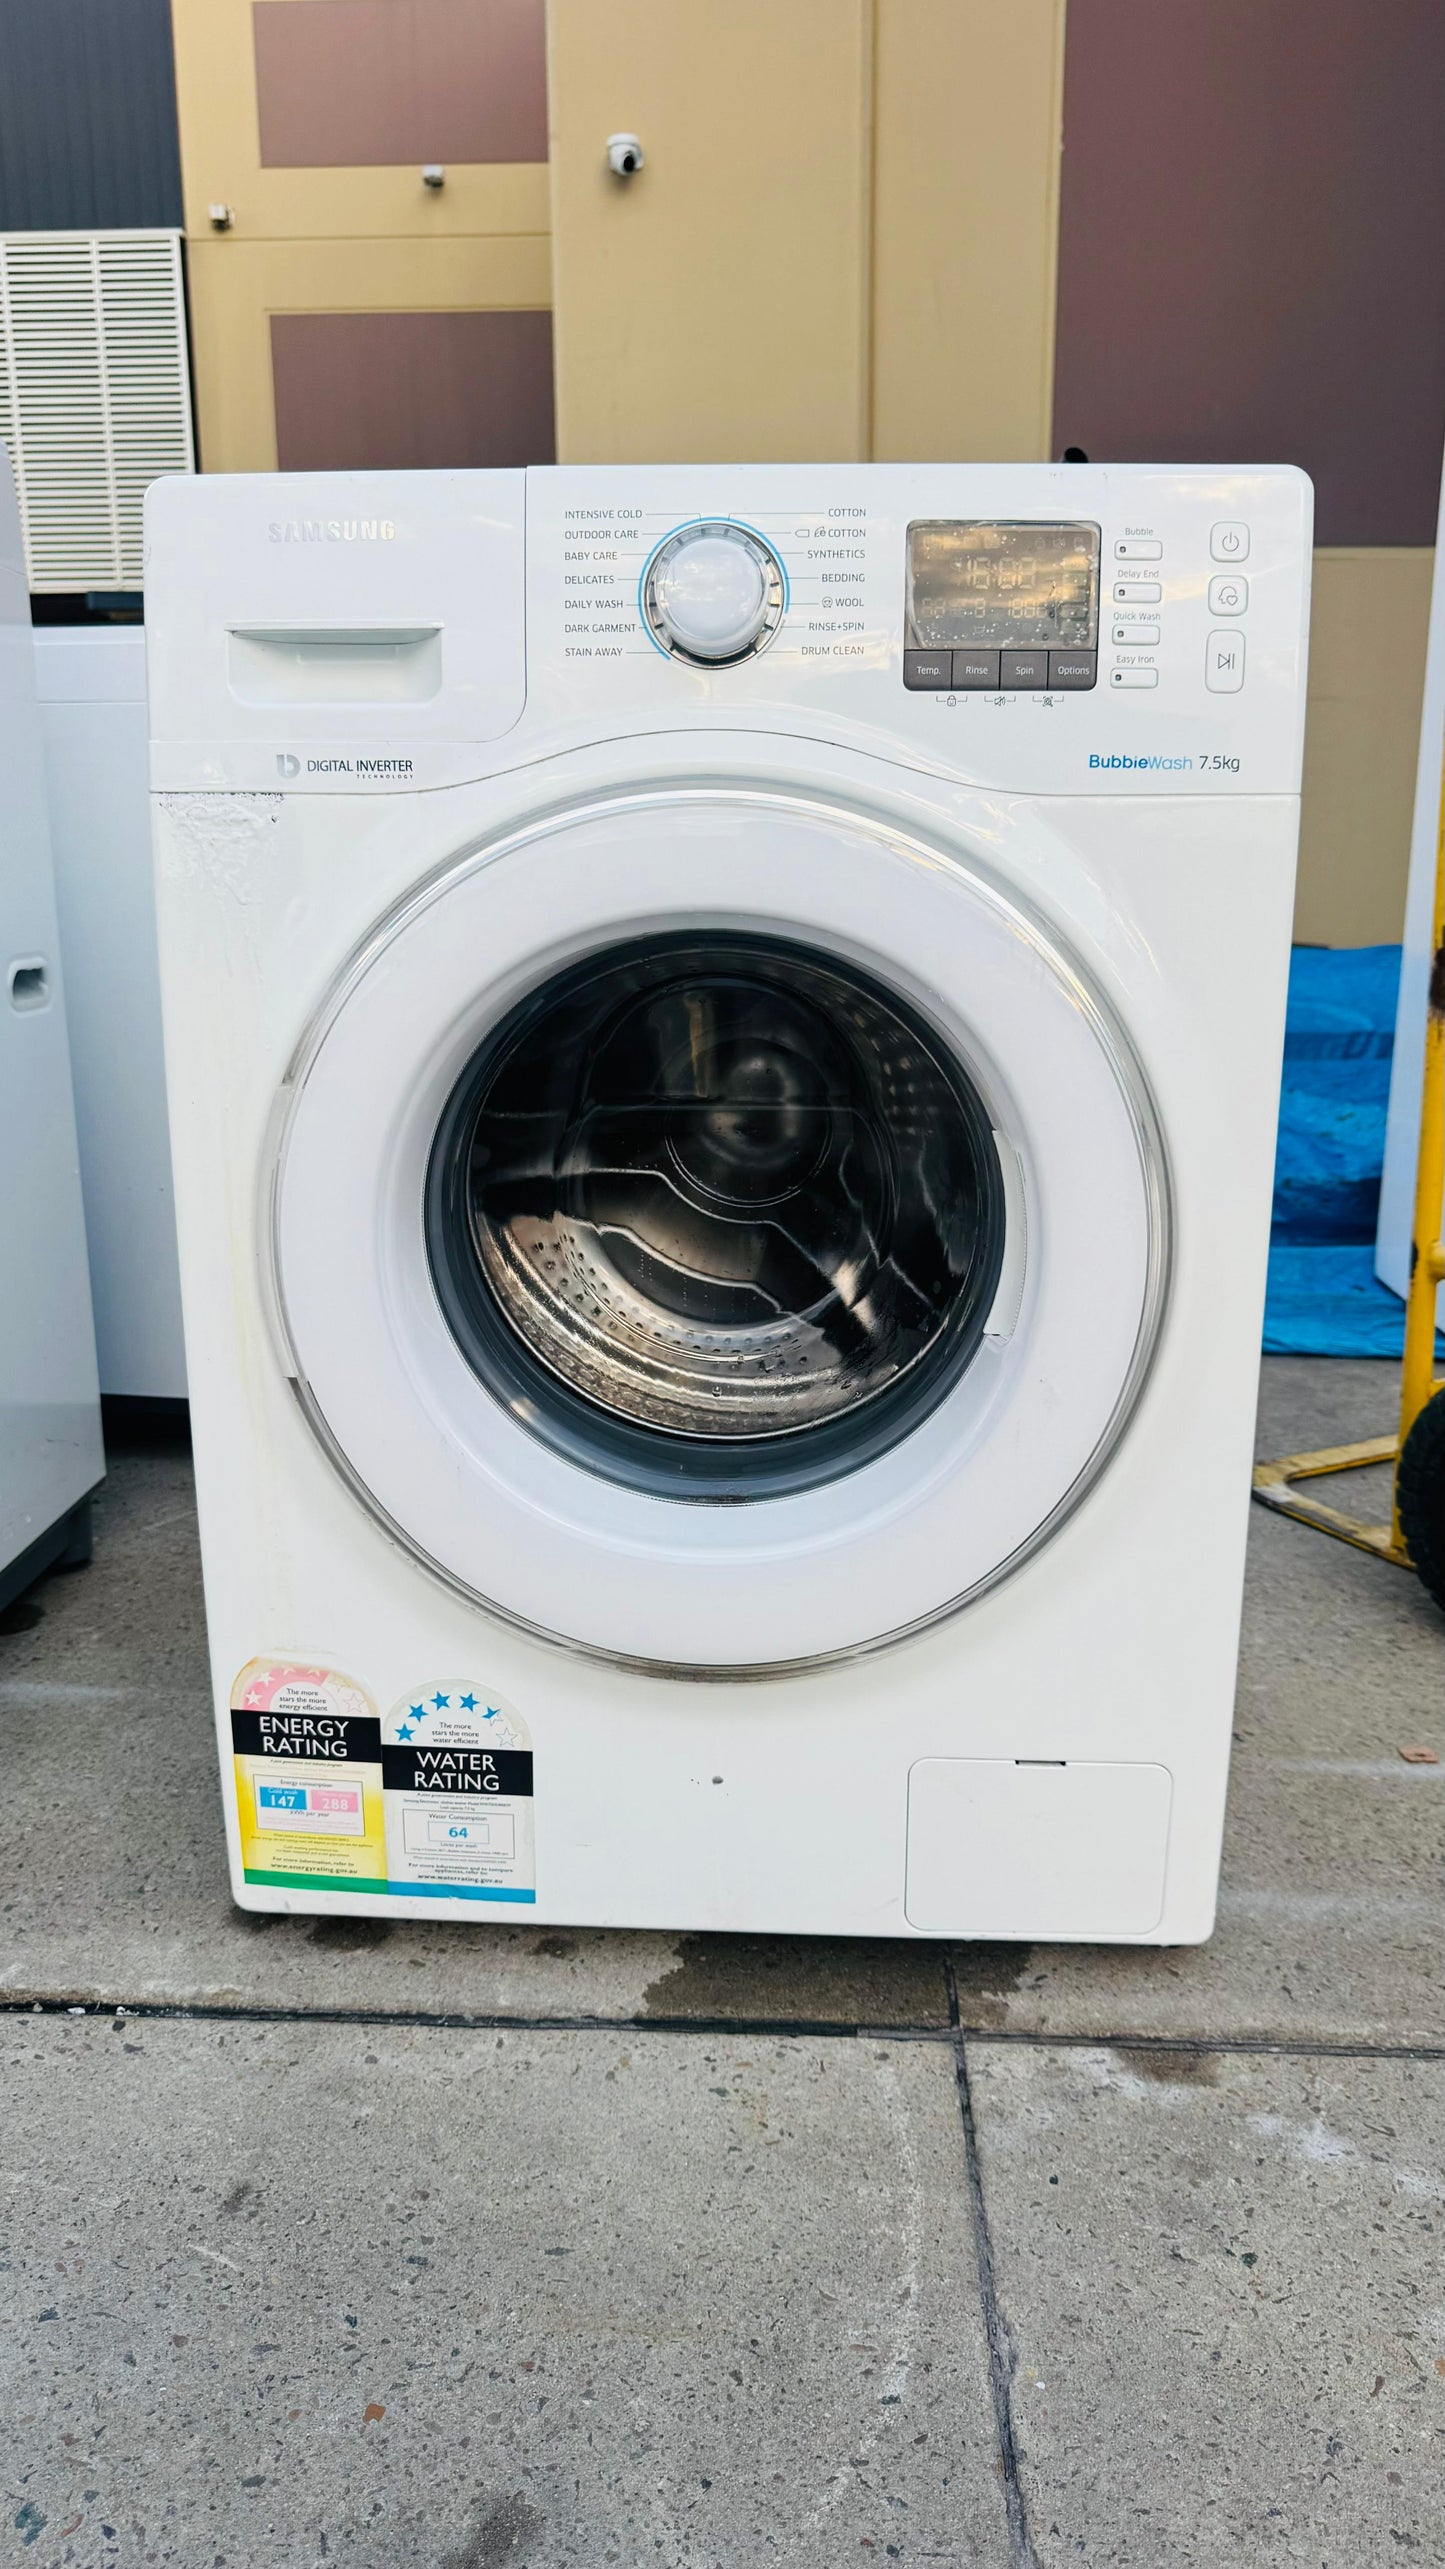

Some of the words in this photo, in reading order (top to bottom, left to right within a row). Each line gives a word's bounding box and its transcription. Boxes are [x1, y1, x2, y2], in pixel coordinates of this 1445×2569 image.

[565, 510, 614, 519] INTENSIVE
[617, 509, 642, 518] COLD
[828, 508, 866, 517] COTTON
[268, 520, 395, 543] SAMSUNG
[565, 530, 611, 539] OUTDOOR
[614, 529, 639, 538] CARE
[828, 529, 866, 537] COTTON
[564, 552, 591, 561] BABY
[593, 551, 618, 560] CARE
[807, 550, 865, 559] SYNTHETICS
[822, 574, 865, 583] BEDDING
[1118, 570, 1141, 579] Delay
[1144, 570, 1159, 578] End
[564, 575, 615, 584] DELICATES
[564, 600, 592, 609] DAILY
[595, 600, 624, 608] WASH
[835, 598, 864, 607] WOOL
[1114, 612, 1136, 620] Quick
[1139, 612, 1160, 620] Wash
[564, 624, 590, 633] DARK
[592, 623, 636, 633] GARMENT
[809, 622, 865, 631] RINSE+SPIN
[565, 648, 593, 656] STAIN
[595, 647, 623, 656] AWAY
[801, 647, 830, 655] DRUM
[833, 646, 864, 655] CLEAN
[1117, 656, 1135, 664] Easy
[1138, 655, 1154, 663] Iron
[917, 667, 941, 676] Temp.
[1016, 667, 1034, 675] Spin
[1058, 667, 1090, 675] Options
[308, 760, 353, 771] DIGITAL
[357, 760, 413, 771] INVERTER
[1200, 755, 1240, 772] 7.5kg
[259, 1716, 350, 1738] ENERGY
[454, 1737, 479, 1745] efficient
[263, 1736, 348, 1758] RATING
[417, 1752, 496, 1771] WATER
[415, 1771, 500, 1791] RATING
[270, 1795, 296, 1807] 147
[322, 1798, 348, 1809] 288
[449, 1827, 468, 1838] 64
